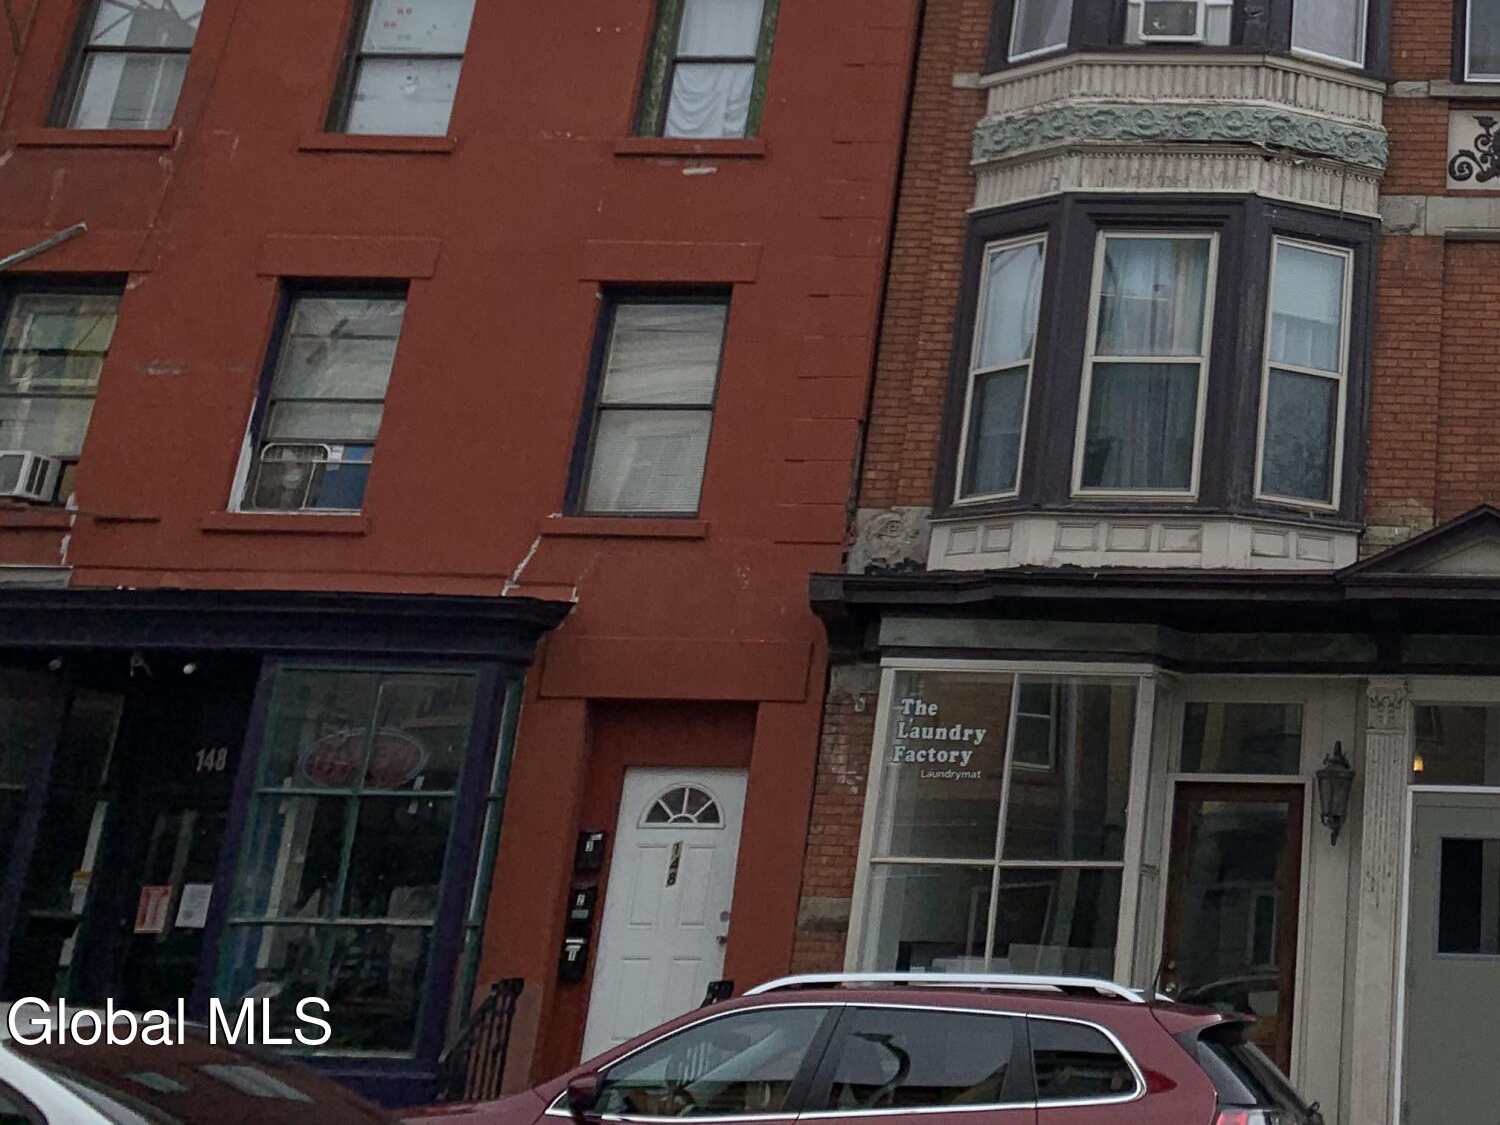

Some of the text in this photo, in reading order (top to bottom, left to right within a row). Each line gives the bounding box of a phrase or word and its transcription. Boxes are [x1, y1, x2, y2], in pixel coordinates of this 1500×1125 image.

[901, 698, 938, 716] The
[896, 721, 987, 745] Laundry
[195, 747, 228, 772] 148
[893, 745, 973, 767] Factory
[920, 769, 982, 781] Laundrymat
